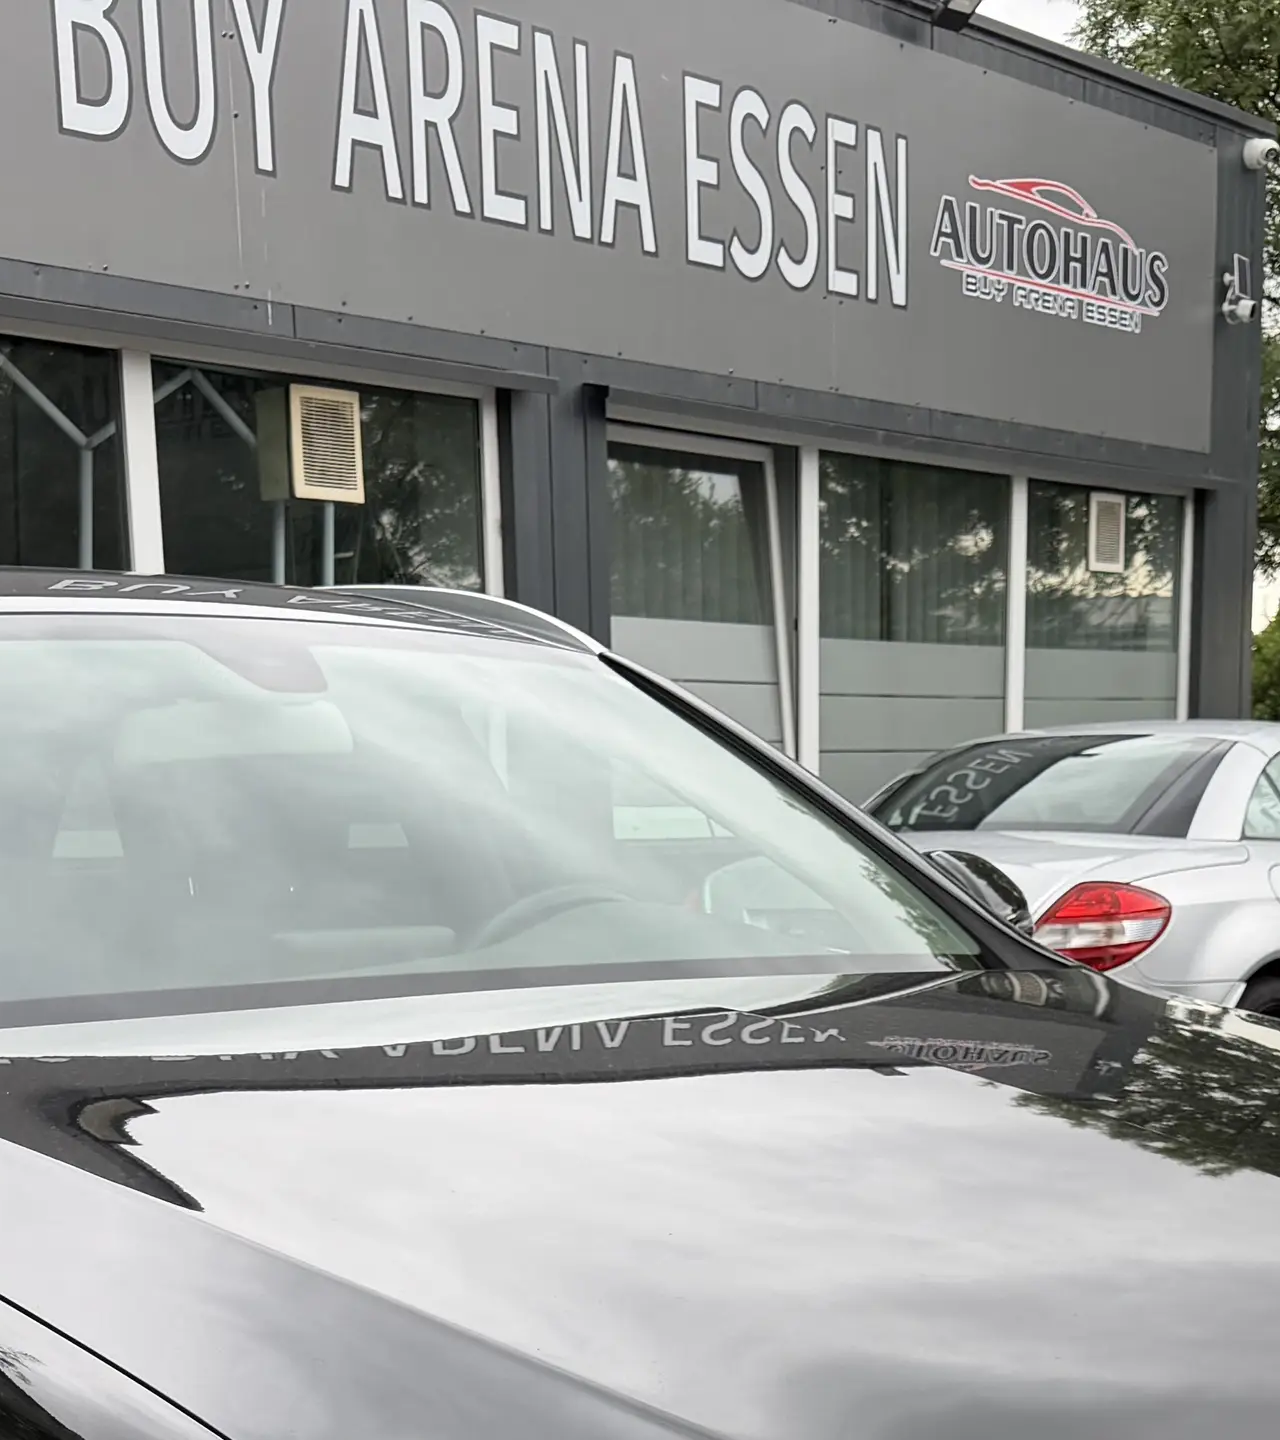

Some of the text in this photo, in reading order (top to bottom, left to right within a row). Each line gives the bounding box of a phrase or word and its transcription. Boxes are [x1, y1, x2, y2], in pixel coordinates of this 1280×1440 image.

[56, 0, 283, 175] BUY
[333, 0, 658, 252] ARENA
[682, 75, 908, 306] ESSEN
[930, 195, 1168, 311] AUTOHAUS
[963, 271, 1141, 333] BUY ARENA ESSEN
